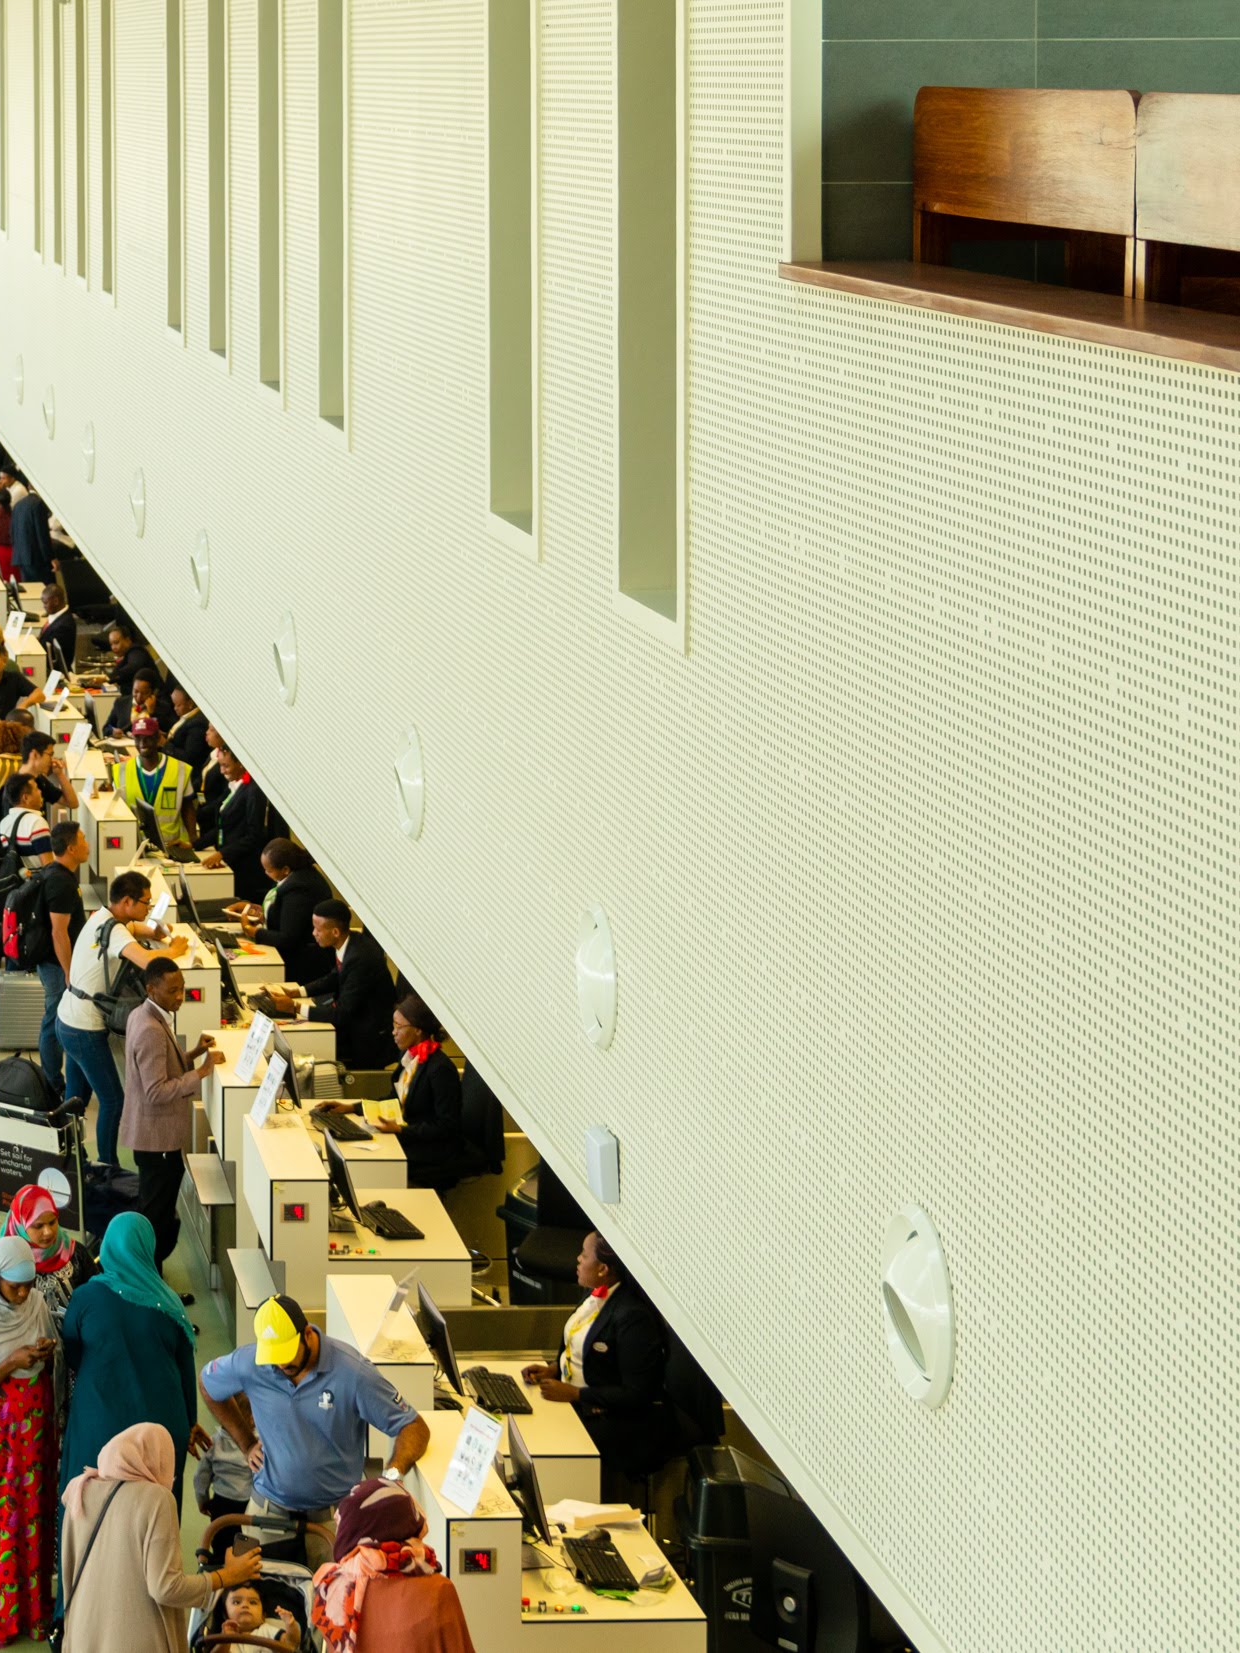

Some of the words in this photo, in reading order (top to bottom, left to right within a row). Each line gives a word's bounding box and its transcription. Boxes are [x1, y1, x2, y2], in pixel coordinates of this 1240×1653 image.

[0, 1148, 10, 1158] Set
[12, 1152, 22, 1160] sail
[24, 1154, 32, 1163] for
[0, 1158, 32, 1172] uncharted
[0, 1167, 24, 1178] waters.
